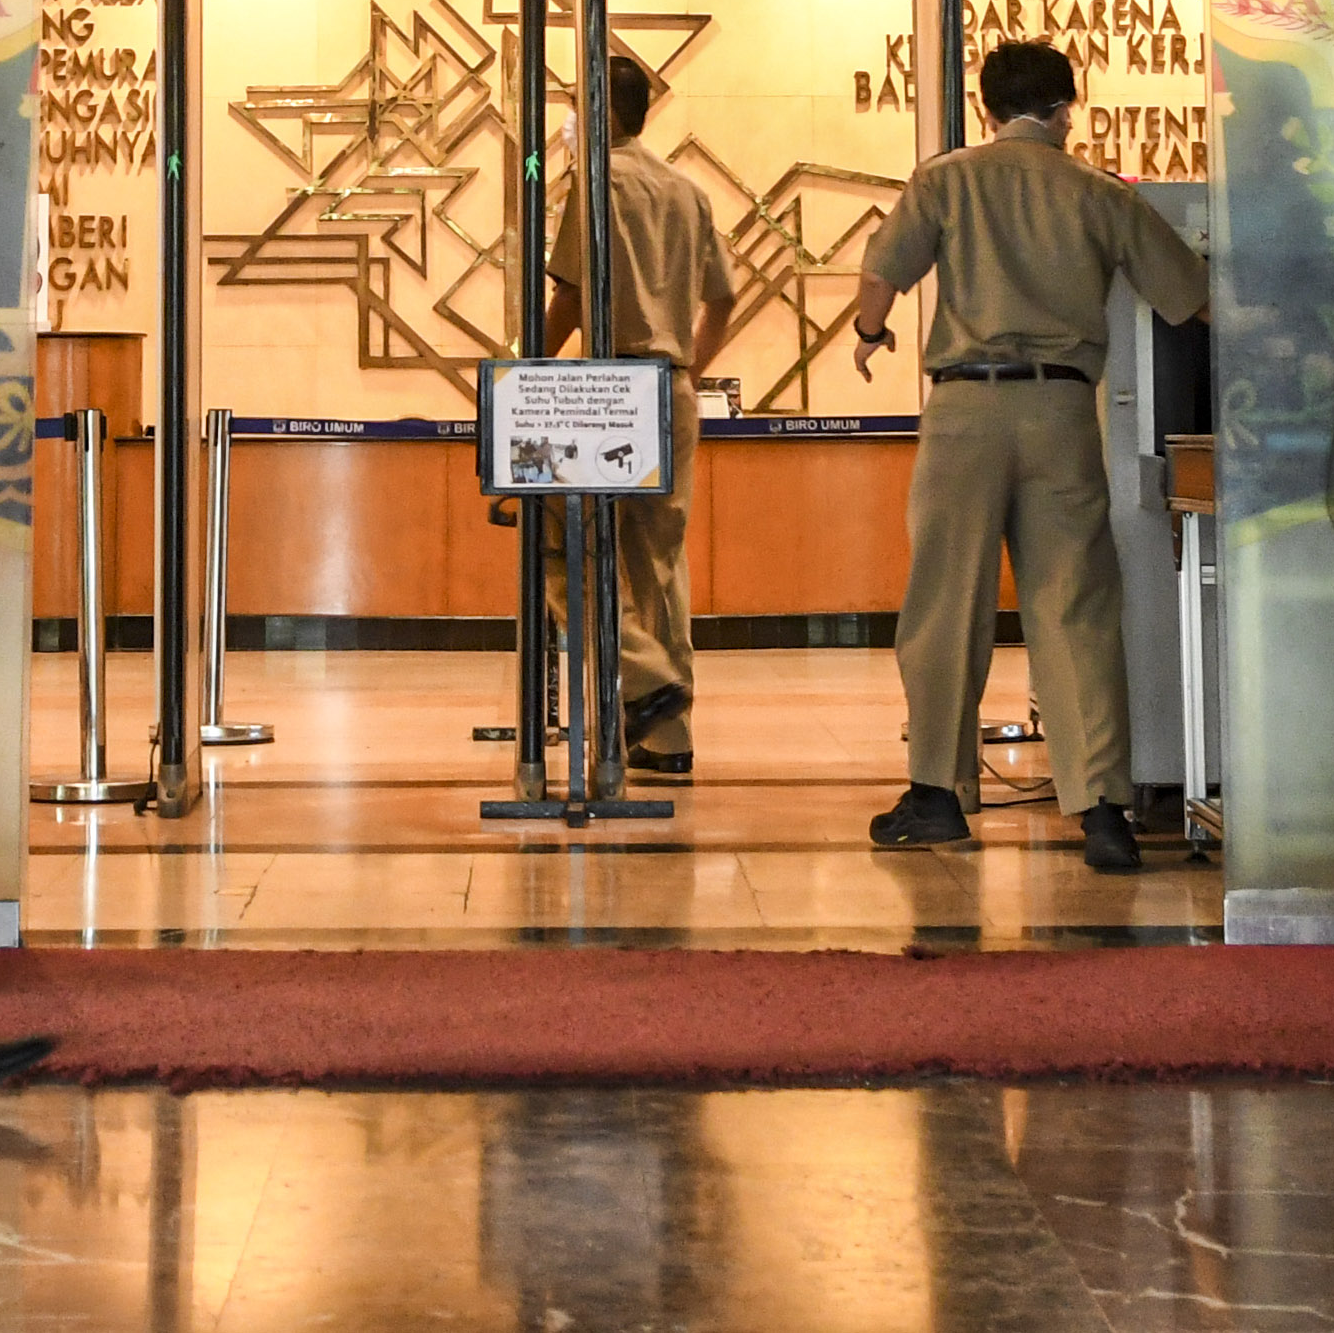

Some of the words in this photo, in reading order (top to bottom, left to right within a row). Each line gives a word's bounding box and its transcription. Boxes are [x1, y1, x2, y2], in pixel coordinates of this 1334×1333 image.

[40, 88, 157, 131] NGASI
[40, 130, 157, 173] UHNYA
[48, 215, 127, 249] BERI
[518, 373, 554, 382] Mohon
[556, 373, 583, 382] Jalan
[586, 373, 631, 382] Perlahan
[518, 385, 556, 395] Sedang
[559, 385, 610, 394] Dilakukan
[612, 385, 631, 394] Cek
[524, 396, 550, 405] Suhu
[553, 396, 584, 405] Tubuh
[586, 396, 625, 407] dengan
[511, 407, 550, 416] Kamera
[553, 407, 601, 416] Pemindai
[603, 407, 638, 416] Termal
[289, 421, 322, 432] BIRO
[324, 422, 365, 433] UMUM
[454, 423, 477, 433] BIR
[785, 420, 818, 431] BIRO
[820, 419, 861, 430] UMUM
